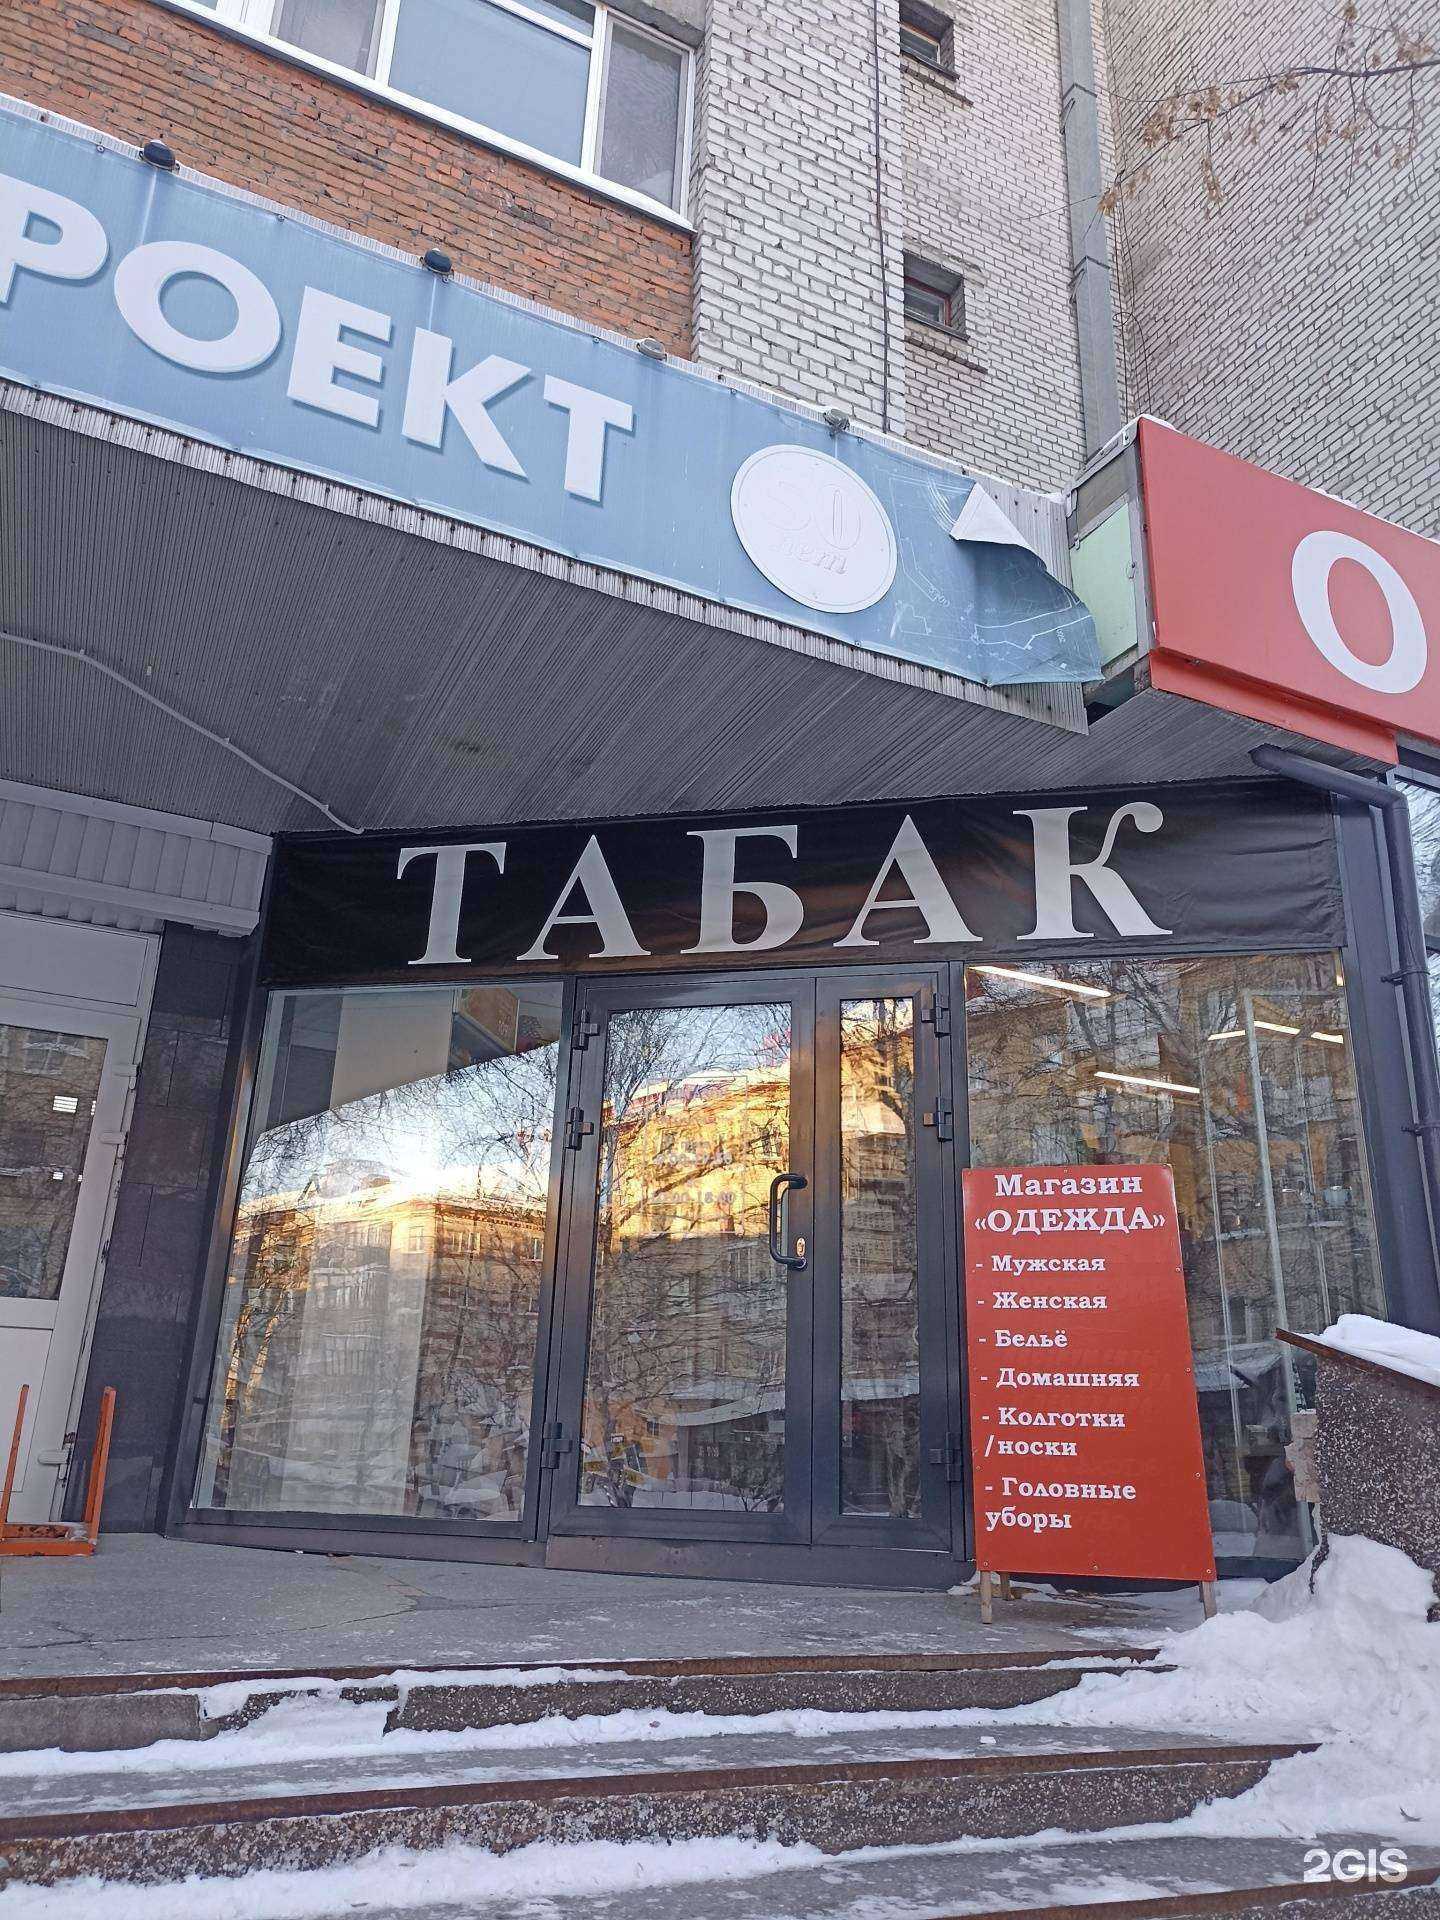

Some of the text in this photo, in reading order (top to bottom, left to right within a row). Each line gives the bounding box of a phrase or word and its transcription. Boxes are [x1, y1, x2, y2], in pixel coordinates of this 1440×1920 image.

[1291, 530, 1428, 694] О
[396, 800, 1173, 966] ТАБАК
[994, 1174, 1143, 1197] Магазин
[974, 1206, 1166, 1235] «ОДЕЖДА»
[991, 1255, 1106, 1276] Мужская
[992, 1292, 1108, 1309] Женская
[994, 1330, 1068, 1348] Бельё
[995, 1367, 1140, 1389] Домашняя
[998, 1407, 1126, 1428] Колготки
[1001, 1477, 1137, 1500] Головные
[985, 1505, 1072, 1533] уборы
